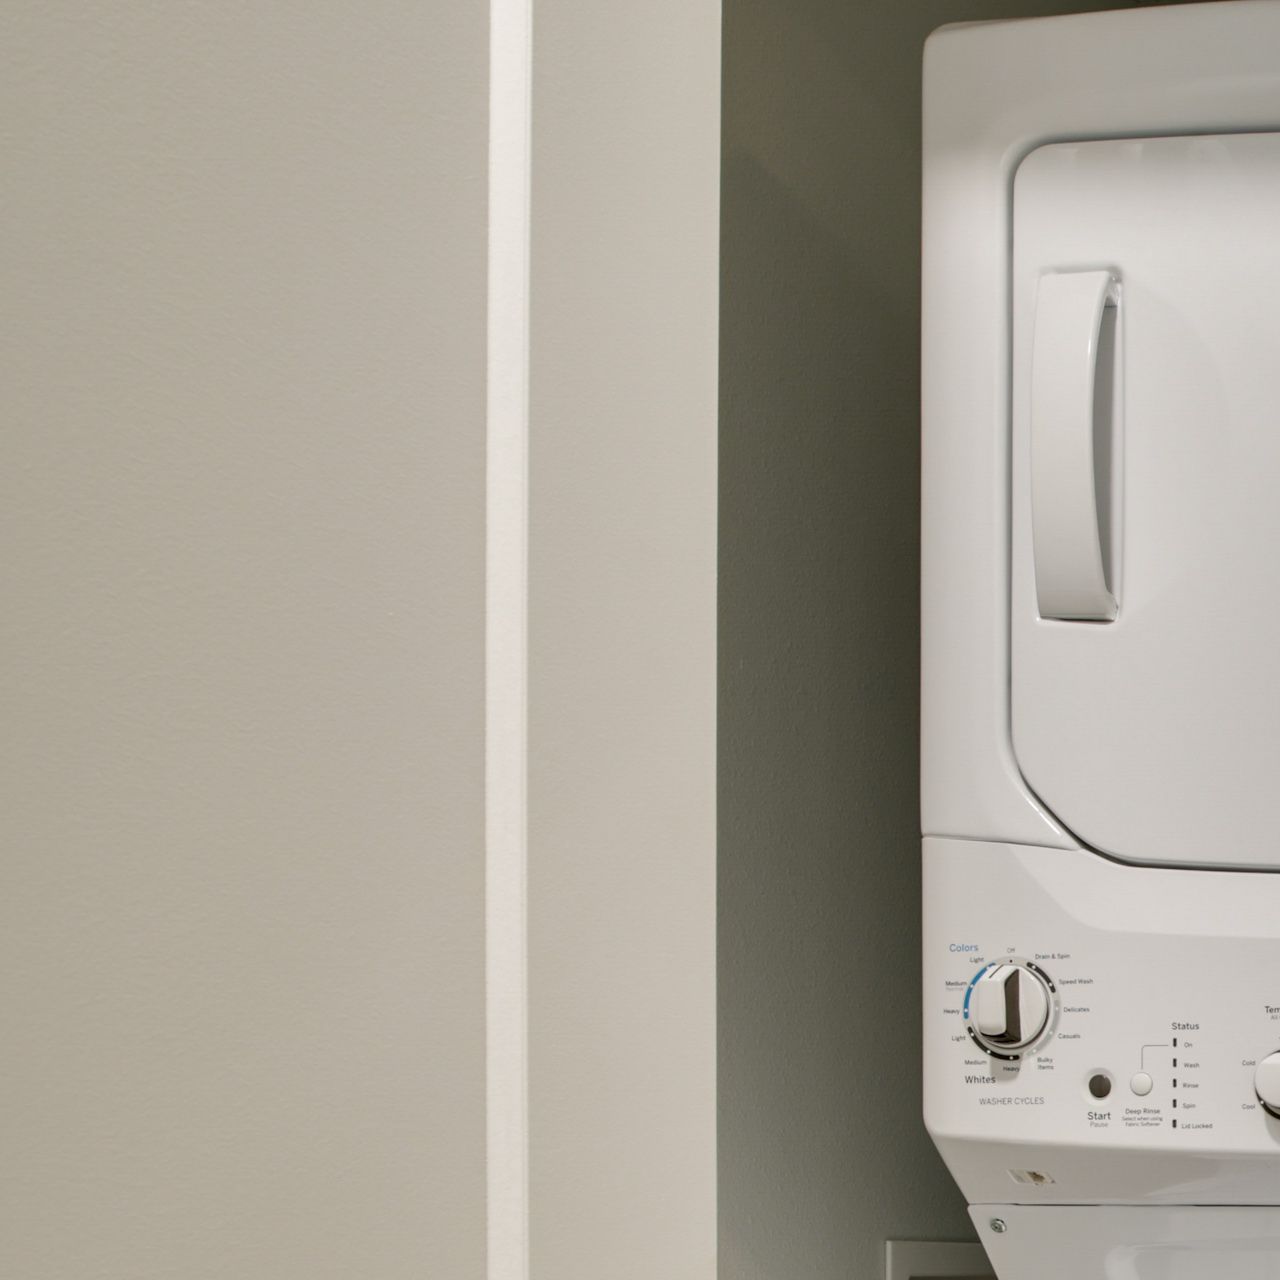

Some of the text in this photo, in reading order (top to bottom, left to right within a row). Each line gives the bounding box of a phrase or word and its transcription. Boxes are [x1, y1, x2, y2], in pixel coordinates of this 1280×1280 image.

[949, 944, 978, 952] Colors
[1172, 1022, 1200, 1030] Status
[965, 1076, 996, 1084] Whites
[1014, 1097, 1045, 1105] CYCLES
[1088, 1112, 1111, 1120] Start
